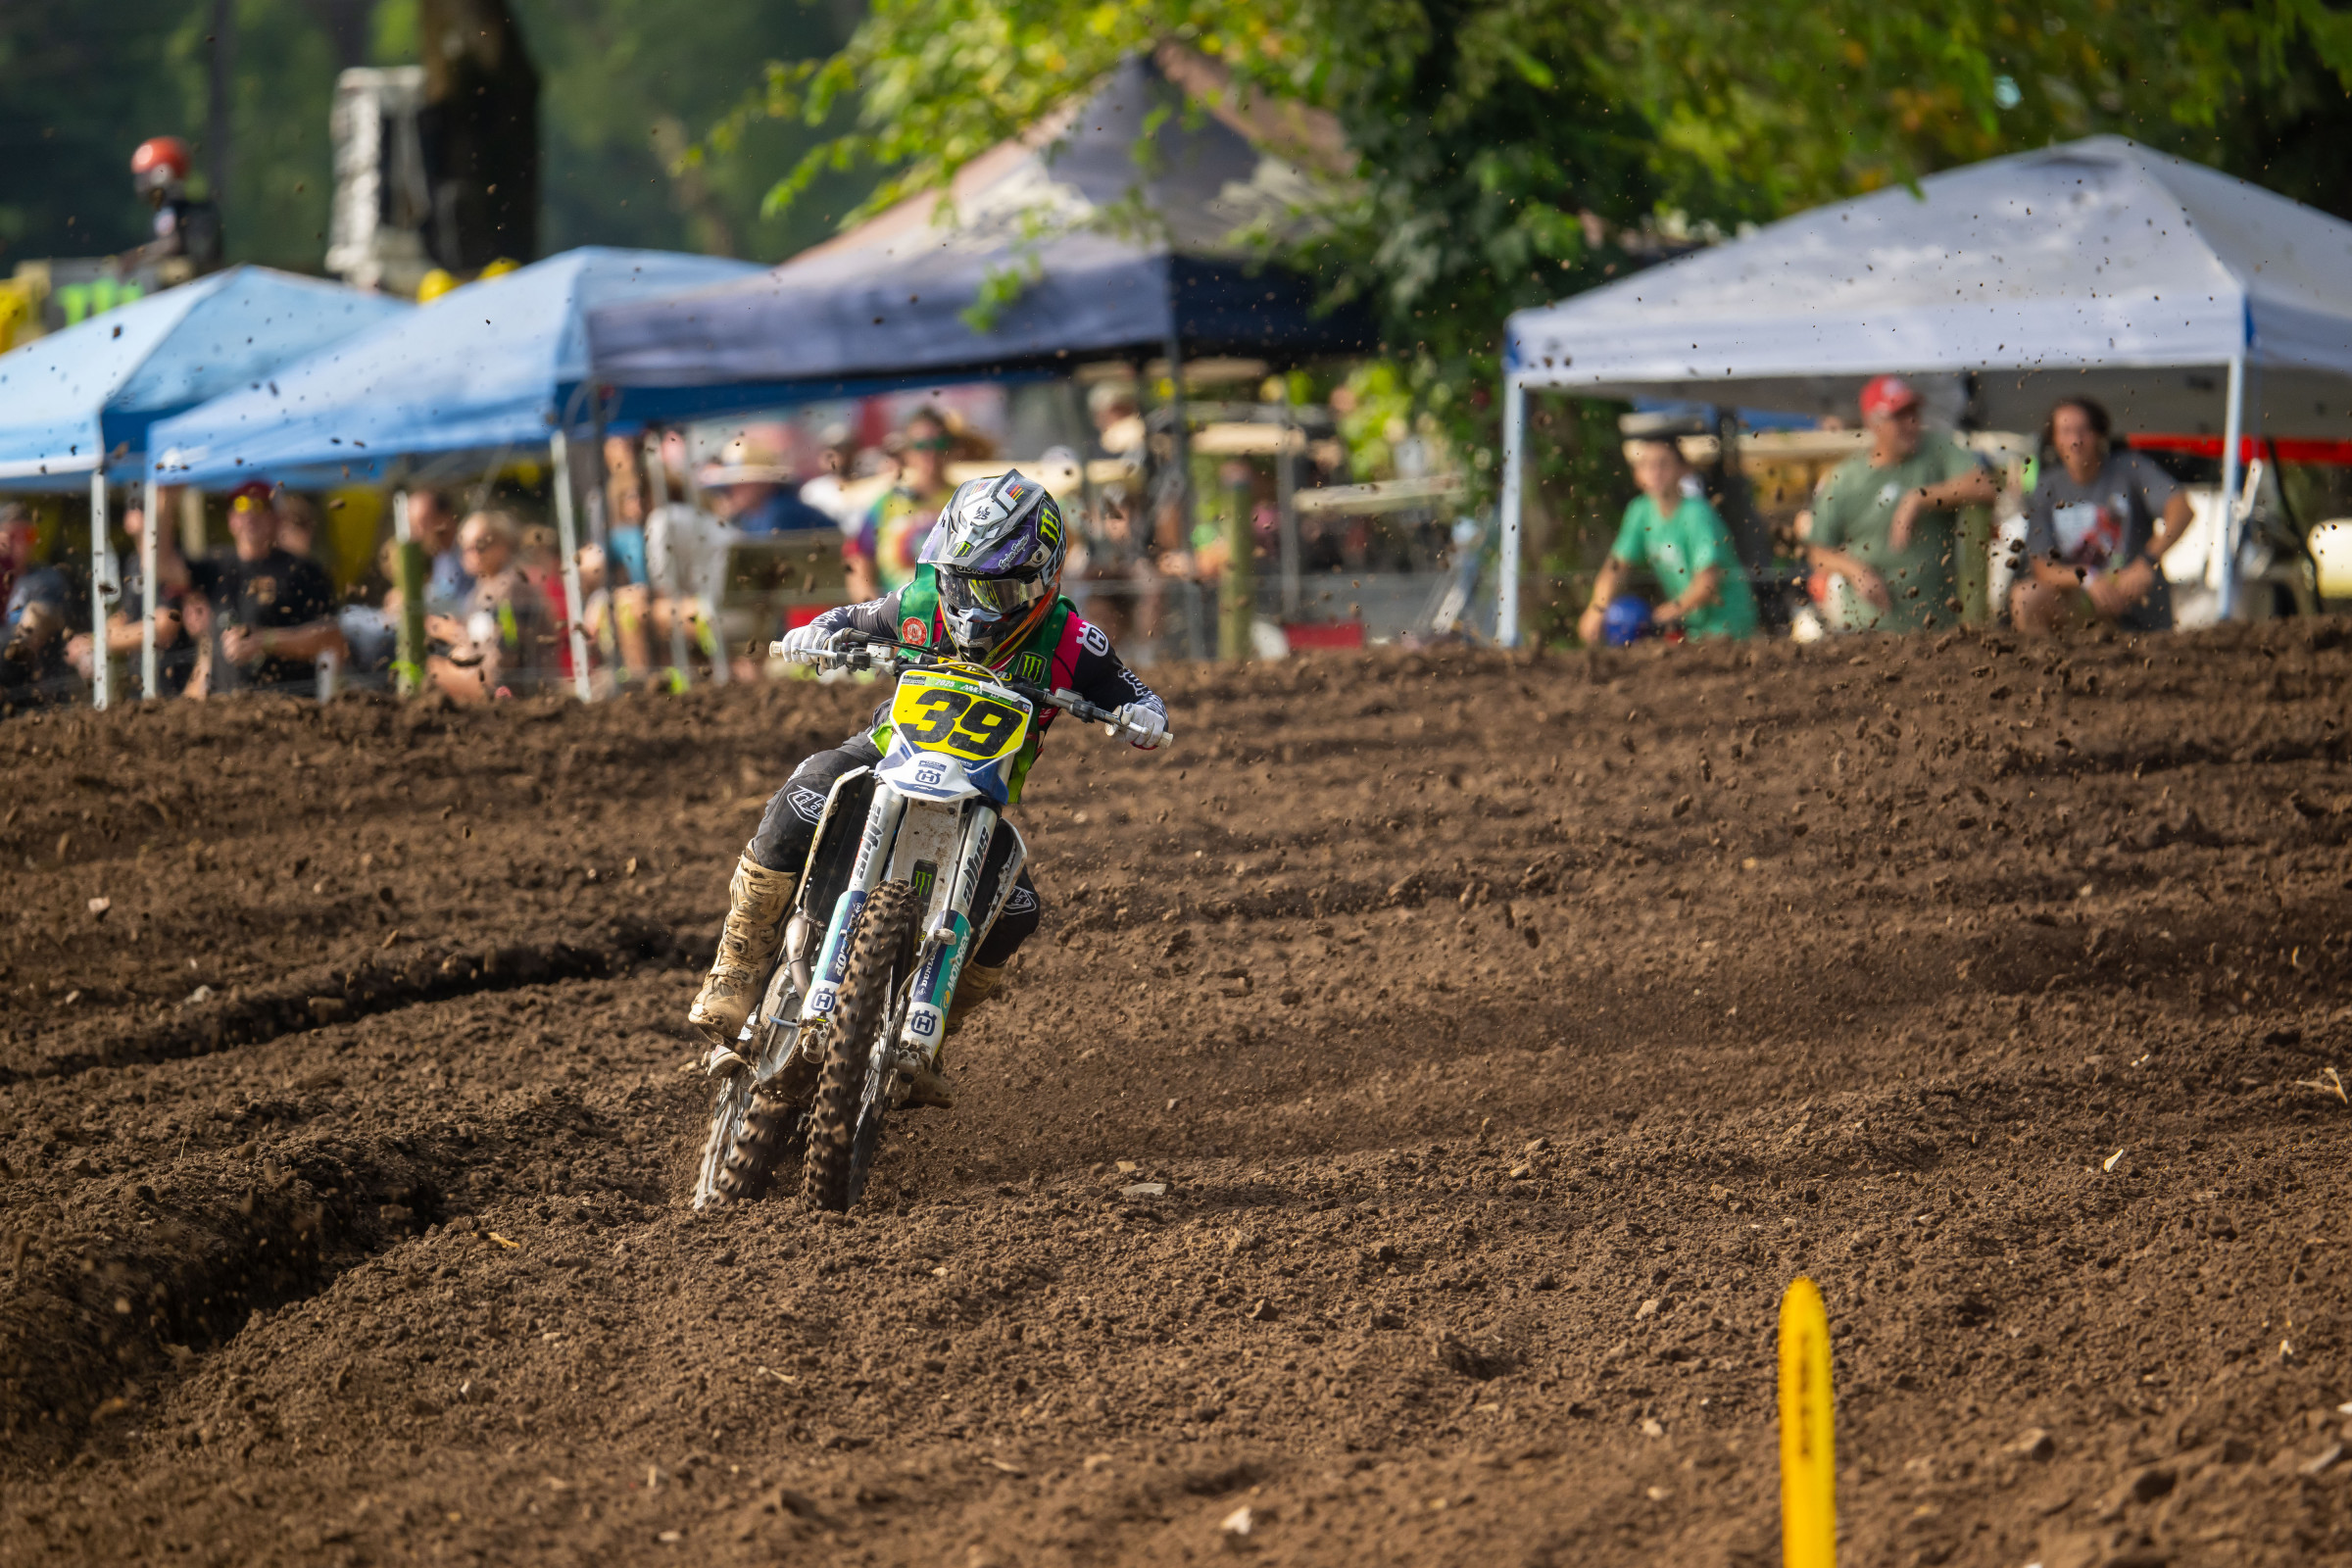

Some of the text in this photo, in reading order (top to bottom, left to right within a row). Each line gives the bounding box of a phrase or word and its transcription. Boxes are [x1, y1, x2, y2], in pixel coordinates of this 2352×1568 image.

[935, 678, 956, 688] 2025
[899, 689, 1023, 758] 39
[921, 949, 937, 988] DUNLO
